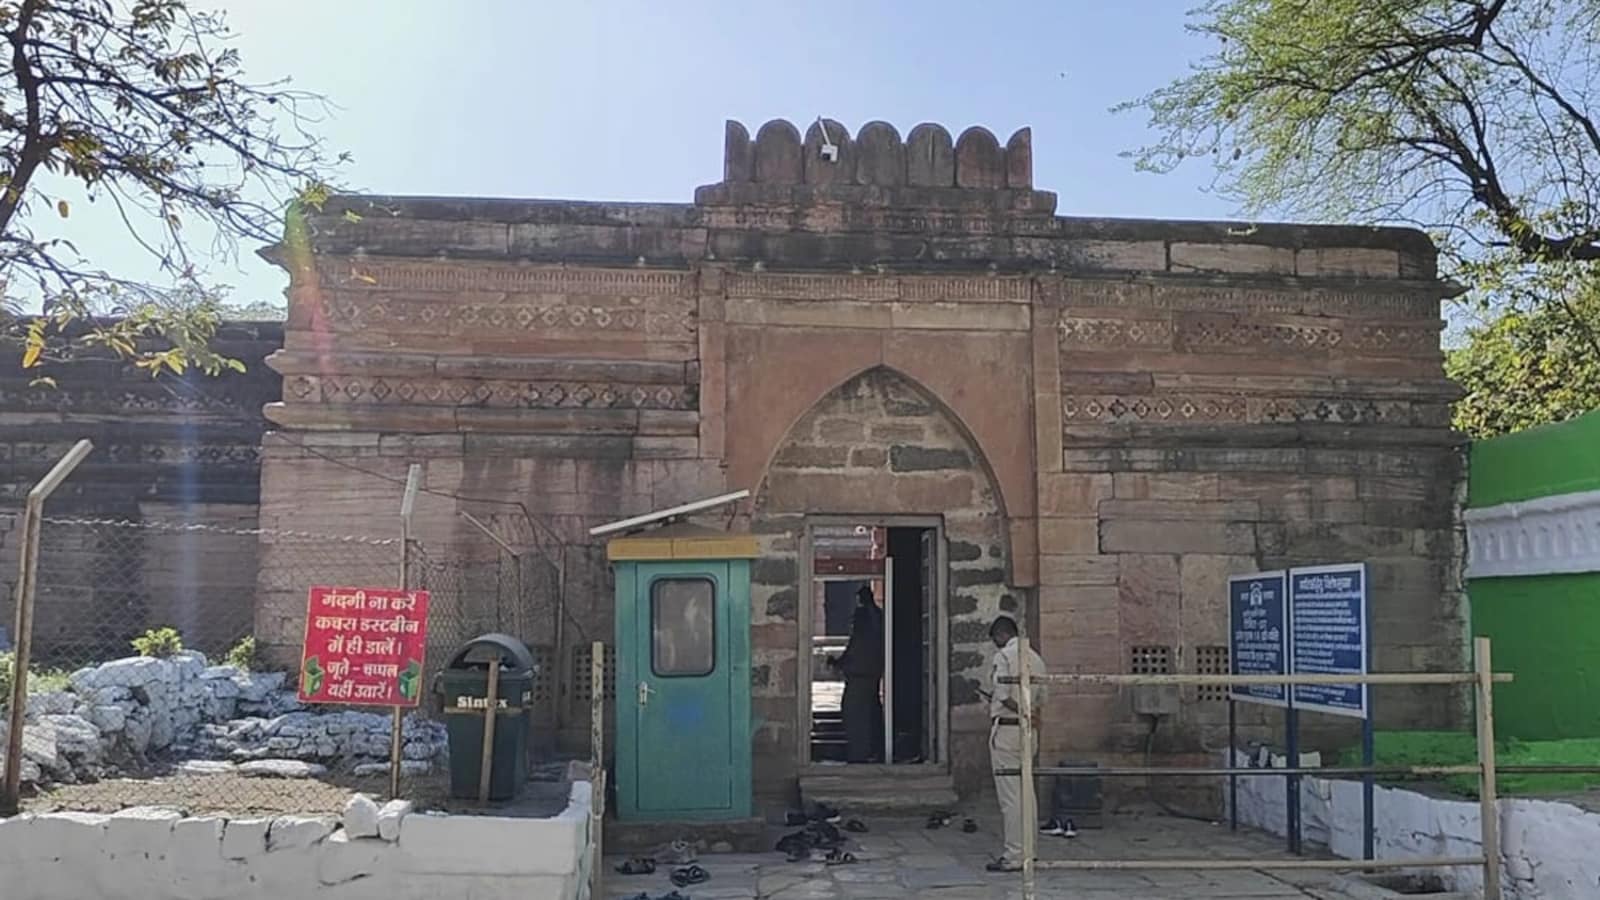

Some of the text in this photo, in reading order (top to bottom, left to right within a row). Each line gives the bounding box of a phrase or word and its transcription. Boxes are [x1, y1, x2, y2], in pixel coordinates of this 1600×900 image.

[322, 590, 416, 611] गंदगी ना करें
[315, 615, 419, 633] कचरा डस्टबीन
[327, 635, 344, 653] में
[346, 635, 363, 655] ही
[327, 658, 350, 680] जूते
[363, 663, 399, 677] चप्पल
[328, 680, 354, 698] यहीं
[457, 695, 508, 709] Sintx
